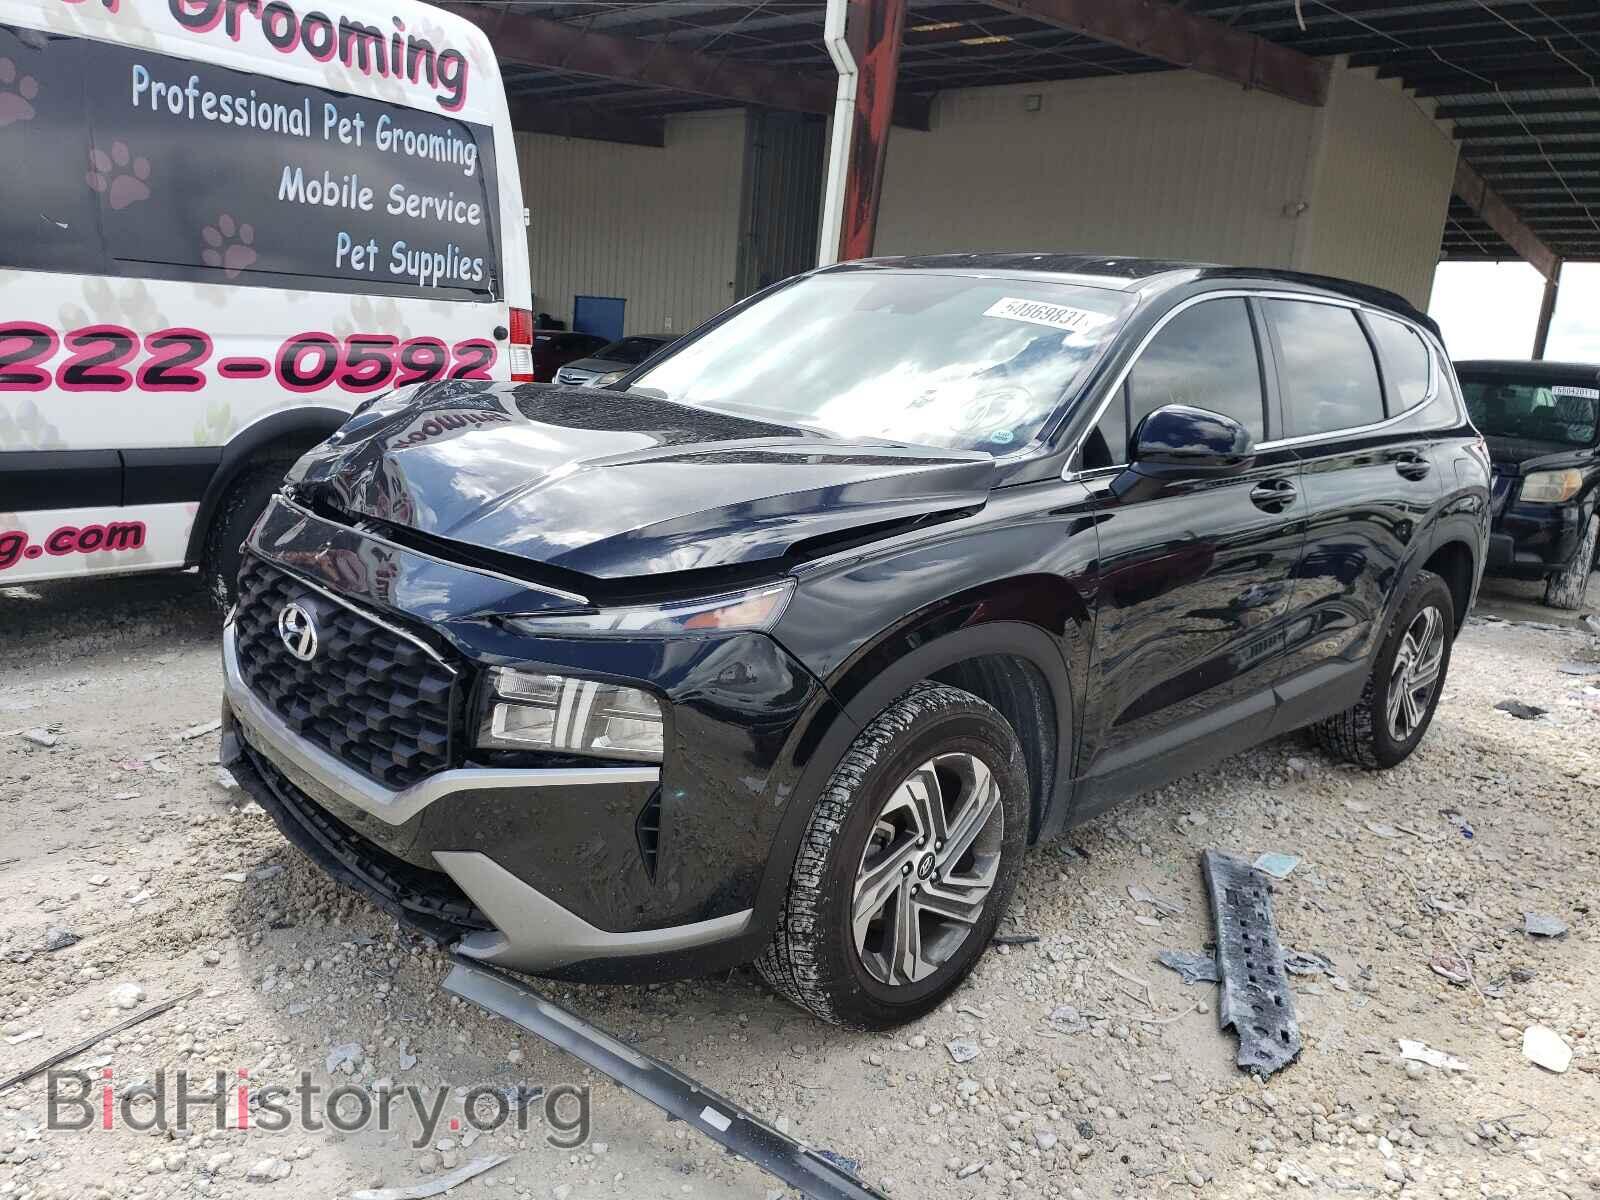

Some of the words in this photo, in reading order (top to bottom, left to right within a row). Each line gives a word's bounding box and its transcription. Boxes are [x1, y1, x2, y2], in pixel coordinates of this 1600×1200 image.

[132, 64, 312, 137] Professional
[324, 103, 365, 147] Pet
[375, 114, 478, 176] Grooming
[278, 165, 374, 211] Mobile
[386, 183, 481, 225] Service
[335, 231, 379, 272] Pet
[389, 240, 484, 288] Supplies
